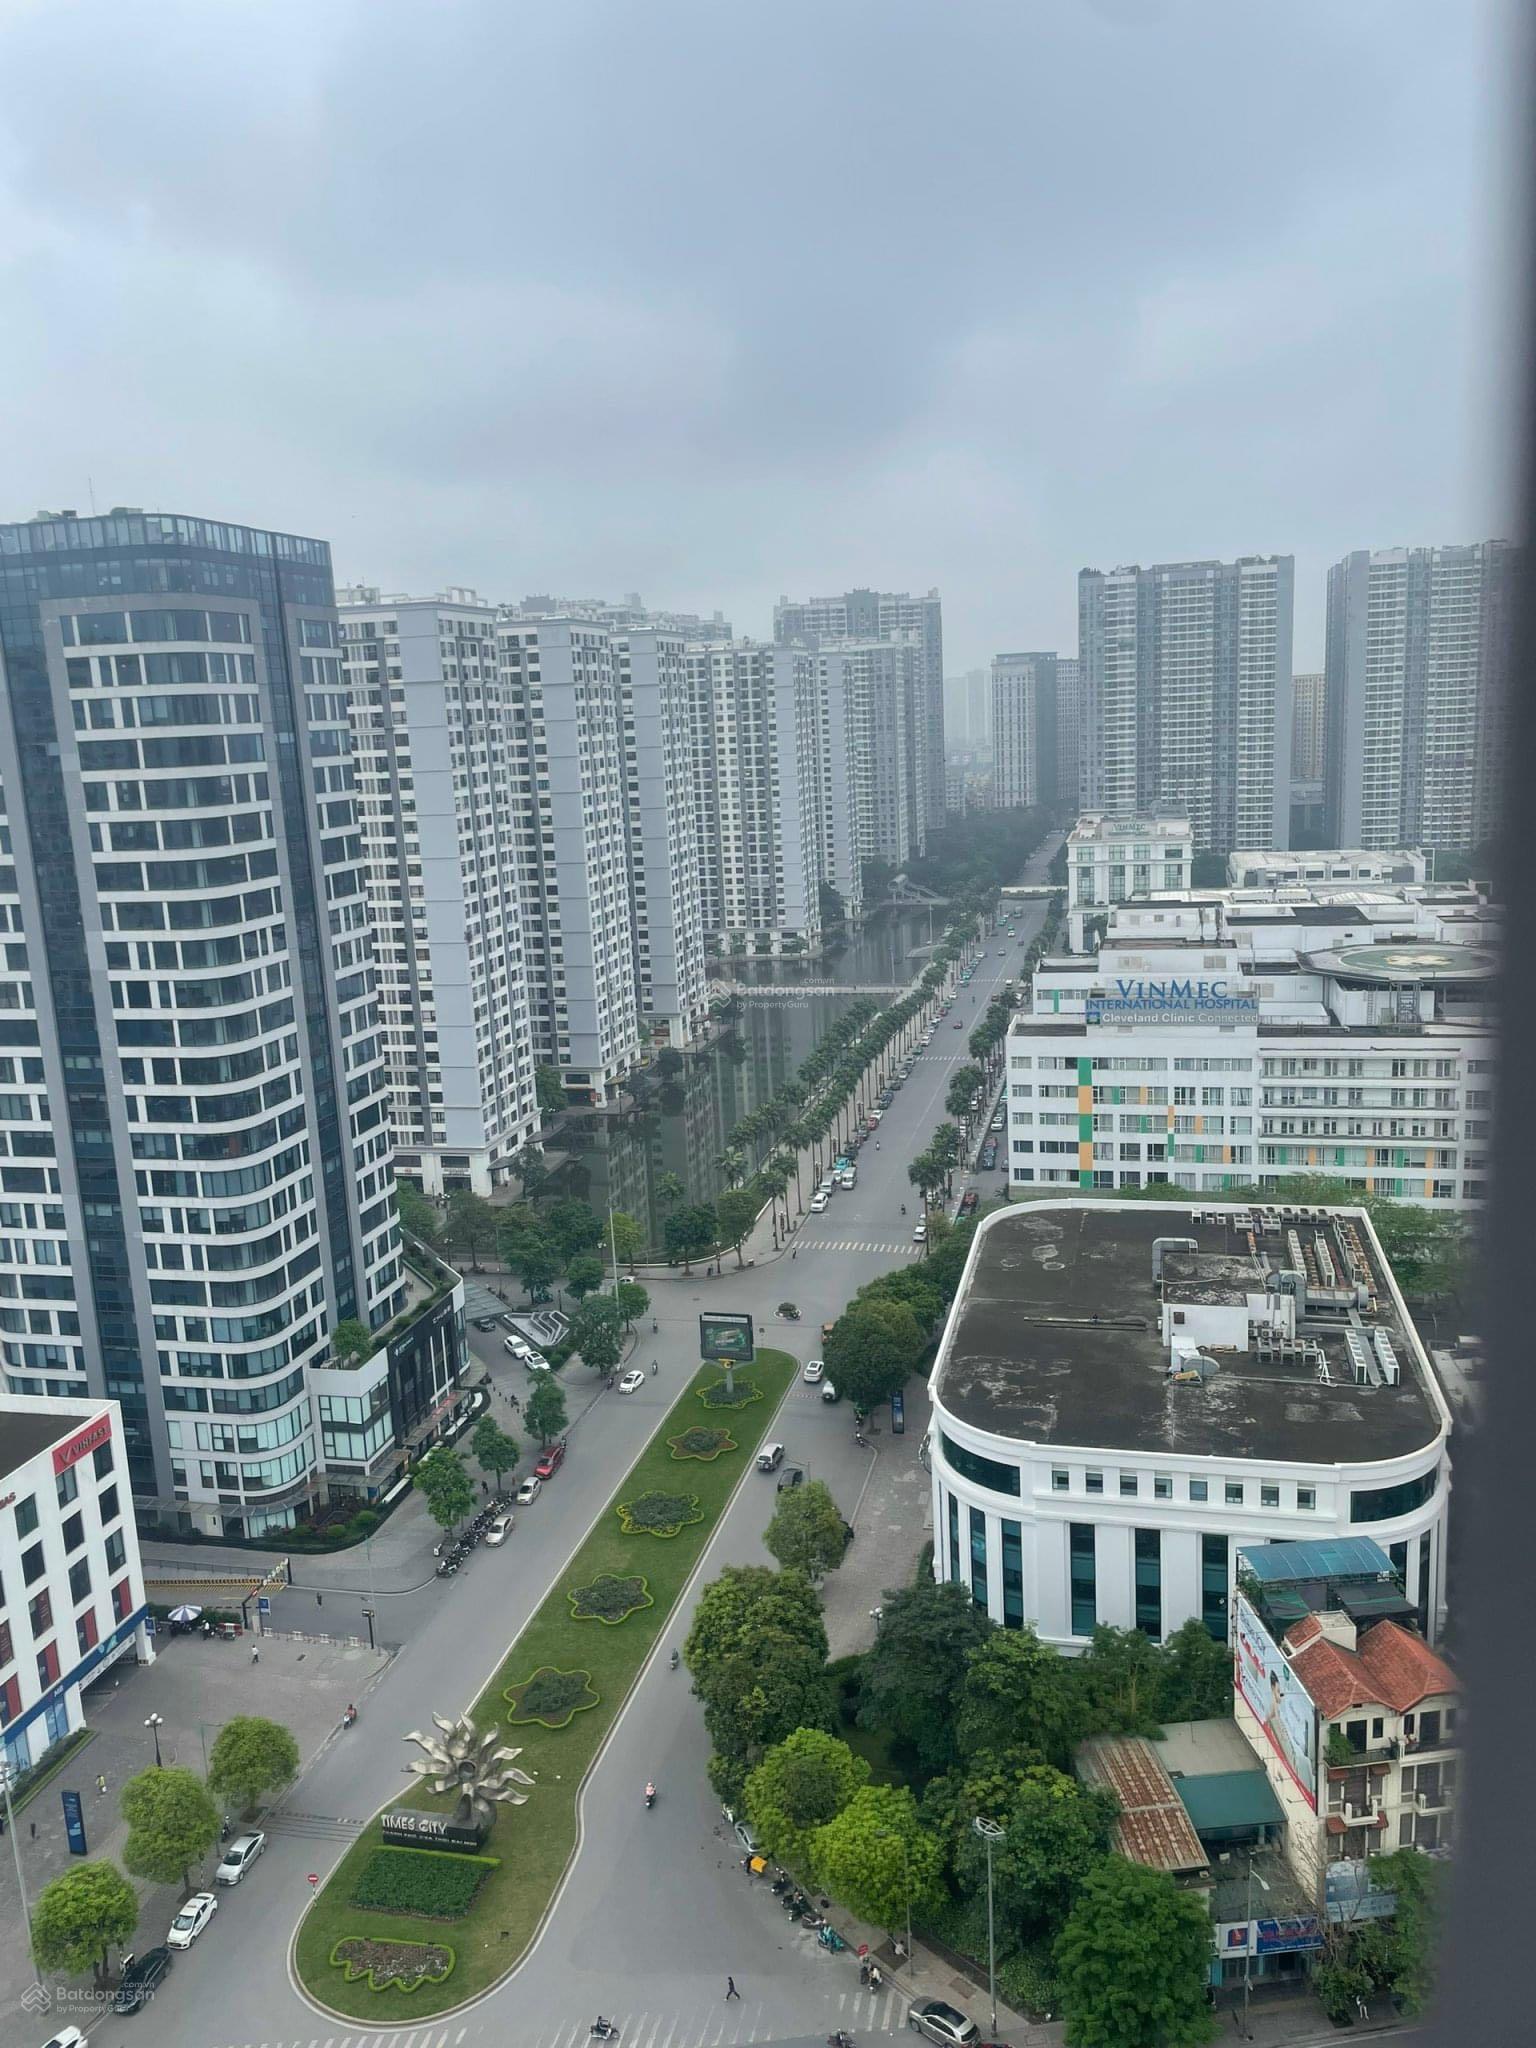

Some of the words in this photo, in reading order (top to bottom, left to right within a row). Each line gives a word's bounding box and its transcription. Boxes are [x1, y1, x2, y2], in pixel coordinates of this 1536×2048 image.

[1086, 999, 1190, 1010] INTERNATIONAL
[1194, 999, 1258, 1010] HOSPITAL
[1102, 1013, 1157, 1023] Cleveland
[1161, 1013, 1195, 1023] Clinic
[1198, 1013, 1258, 1023] Connected
[381, 1815, 415, 1831] TIMES
[419, 1820, 448, 1835] CITY
